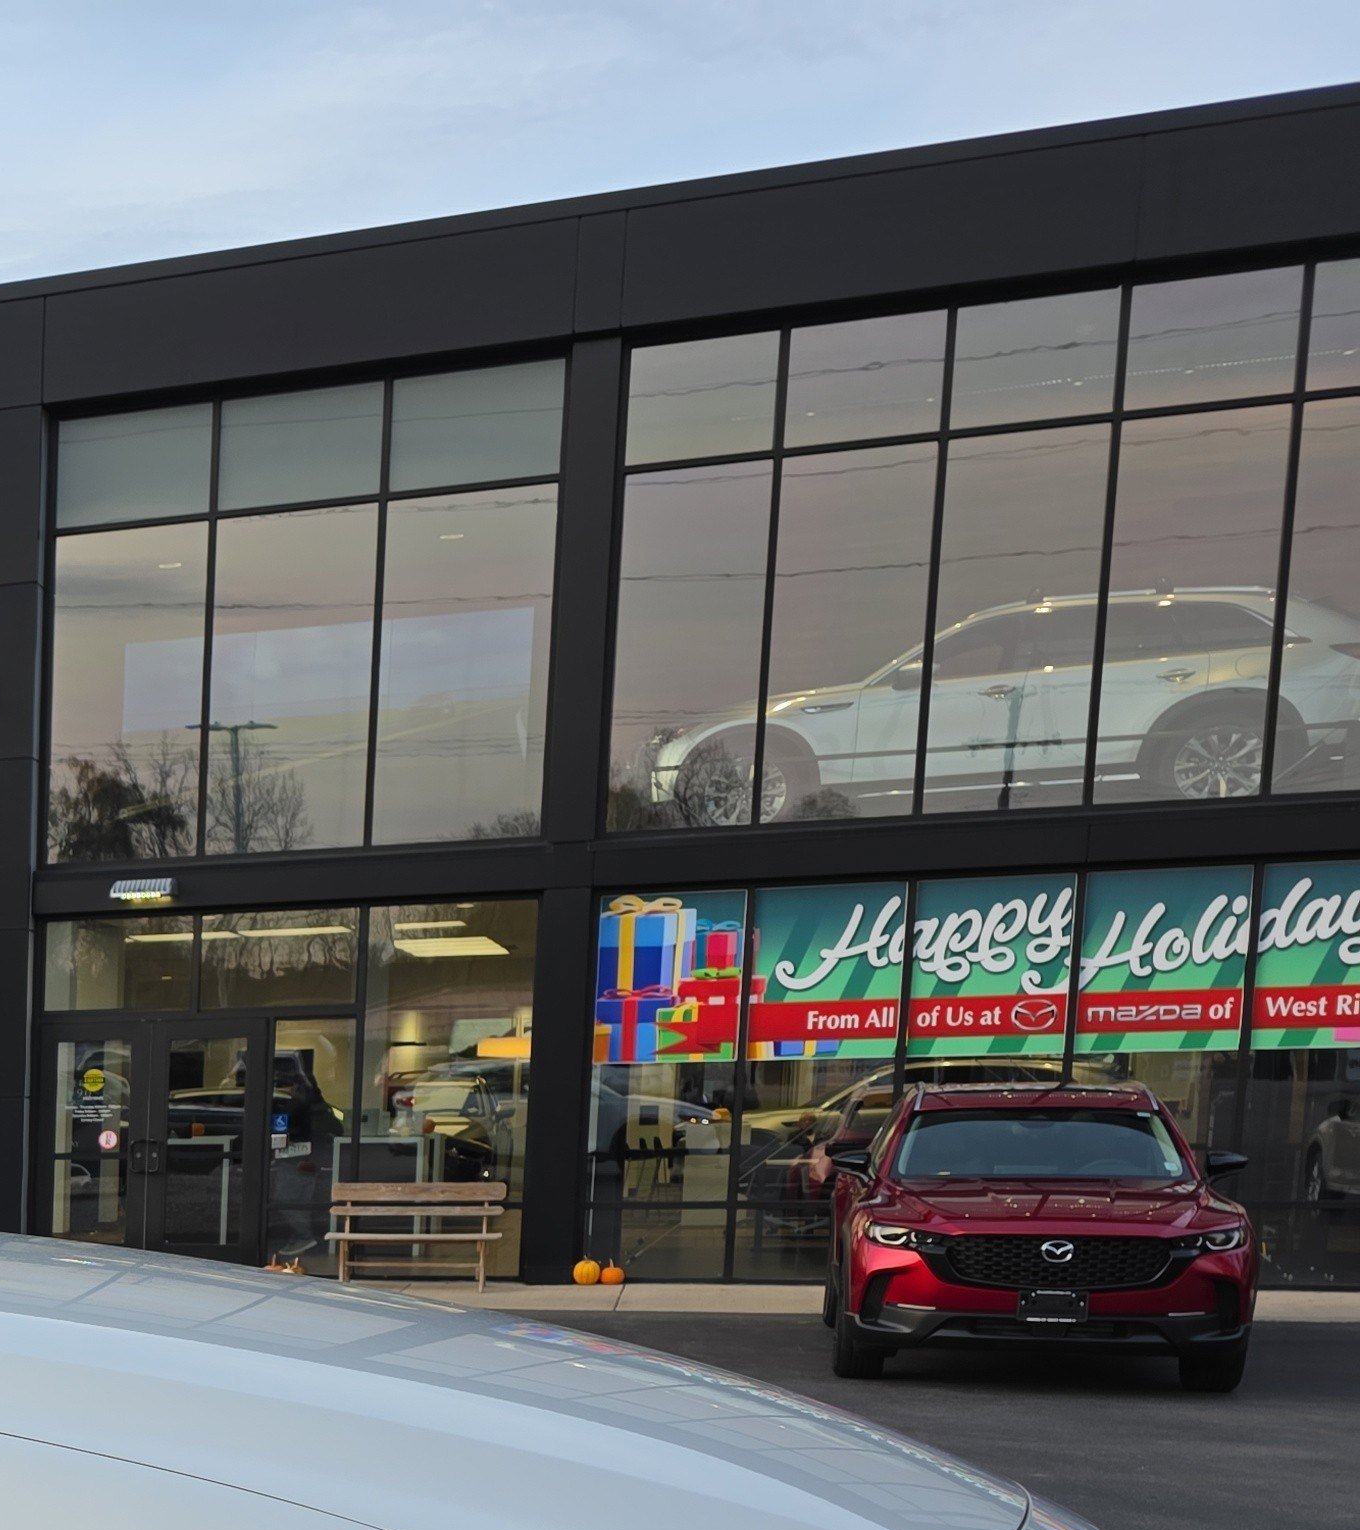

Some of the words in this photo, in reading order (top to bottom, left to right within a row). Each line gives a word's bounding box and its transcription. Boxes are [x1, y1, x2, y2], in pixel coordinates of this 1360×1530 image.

[775, 887, 1072, 990] Happy
[806, 1010, 859, 1030] From
[865, 1006, 895, 1028] All
[917, 1006, 939, 1027] of
[946, 1006, 974, 1027] Us
[980, 1006, 1002, 1026] at
[1209, 996, 1235, 1019] of
[1266, 996, 1328, 1018] West
